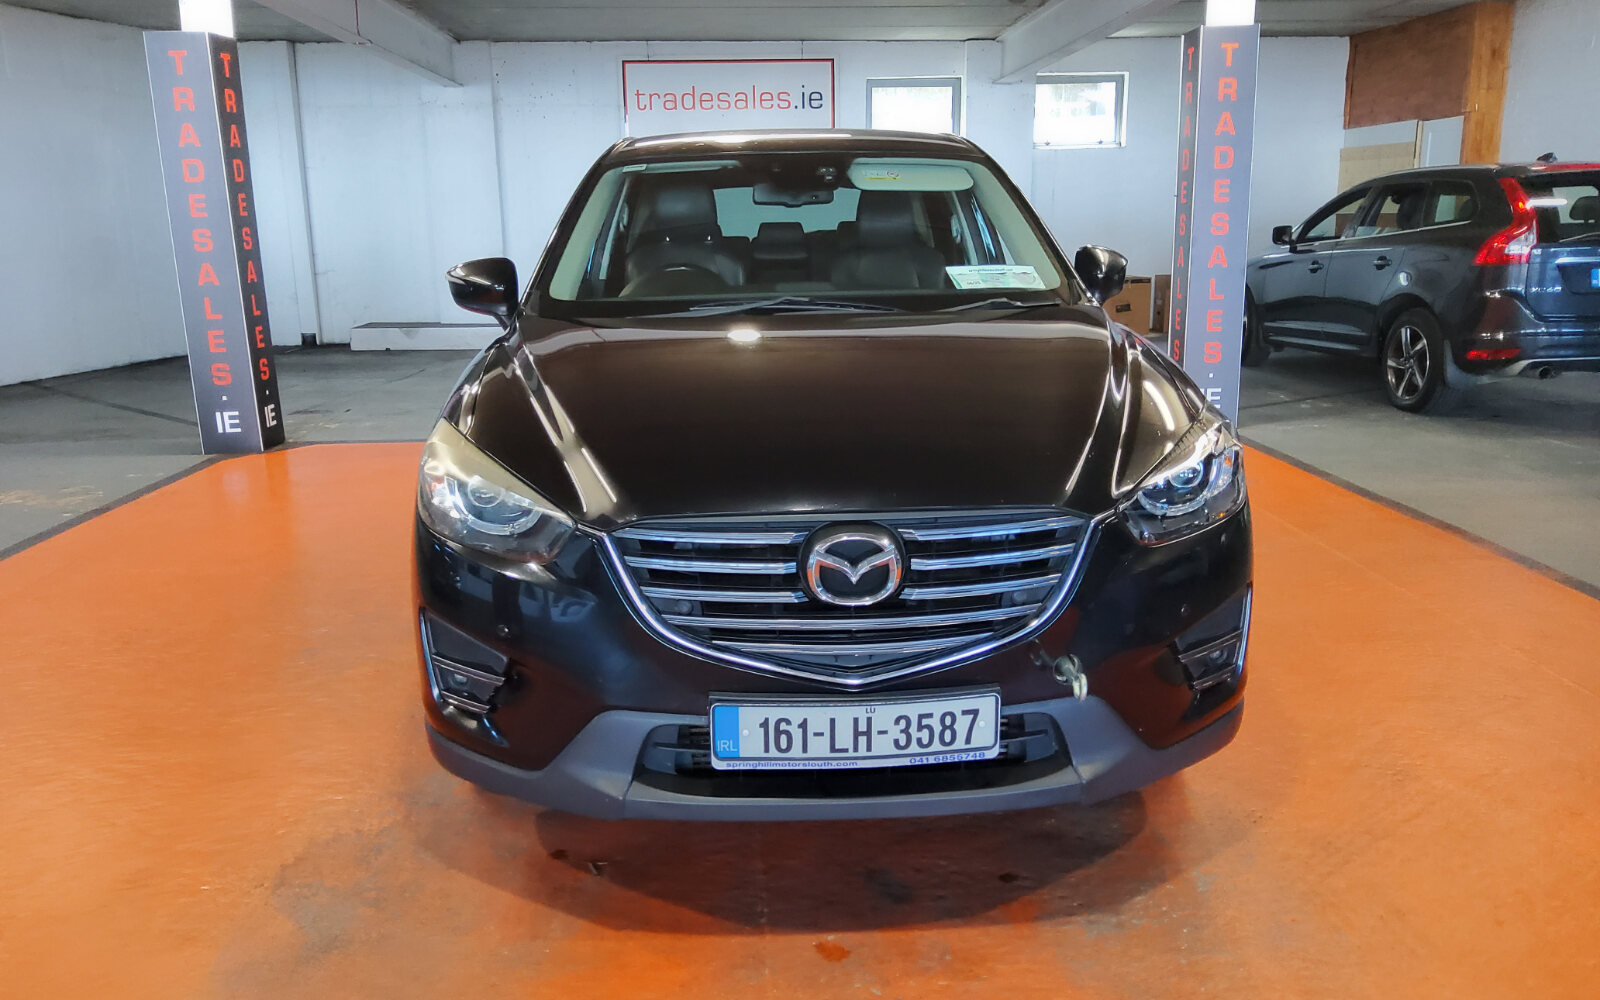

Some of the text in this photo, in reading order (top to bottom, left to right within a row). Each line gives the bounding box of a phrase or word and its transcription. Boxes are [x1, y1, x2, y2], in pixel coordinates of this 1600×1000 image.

[634, 85, 824, 111] tradesales.ie
[167, 50, 242, 434] TRADESALES.IE
[220, 52, 278, 428] TRADESALES.IE
[717, 740, 738, 752] IRL
[758, 708, 980, 754] 161-LH-3587
[726, 760, 858, 769] springhillmotorslouth.com
